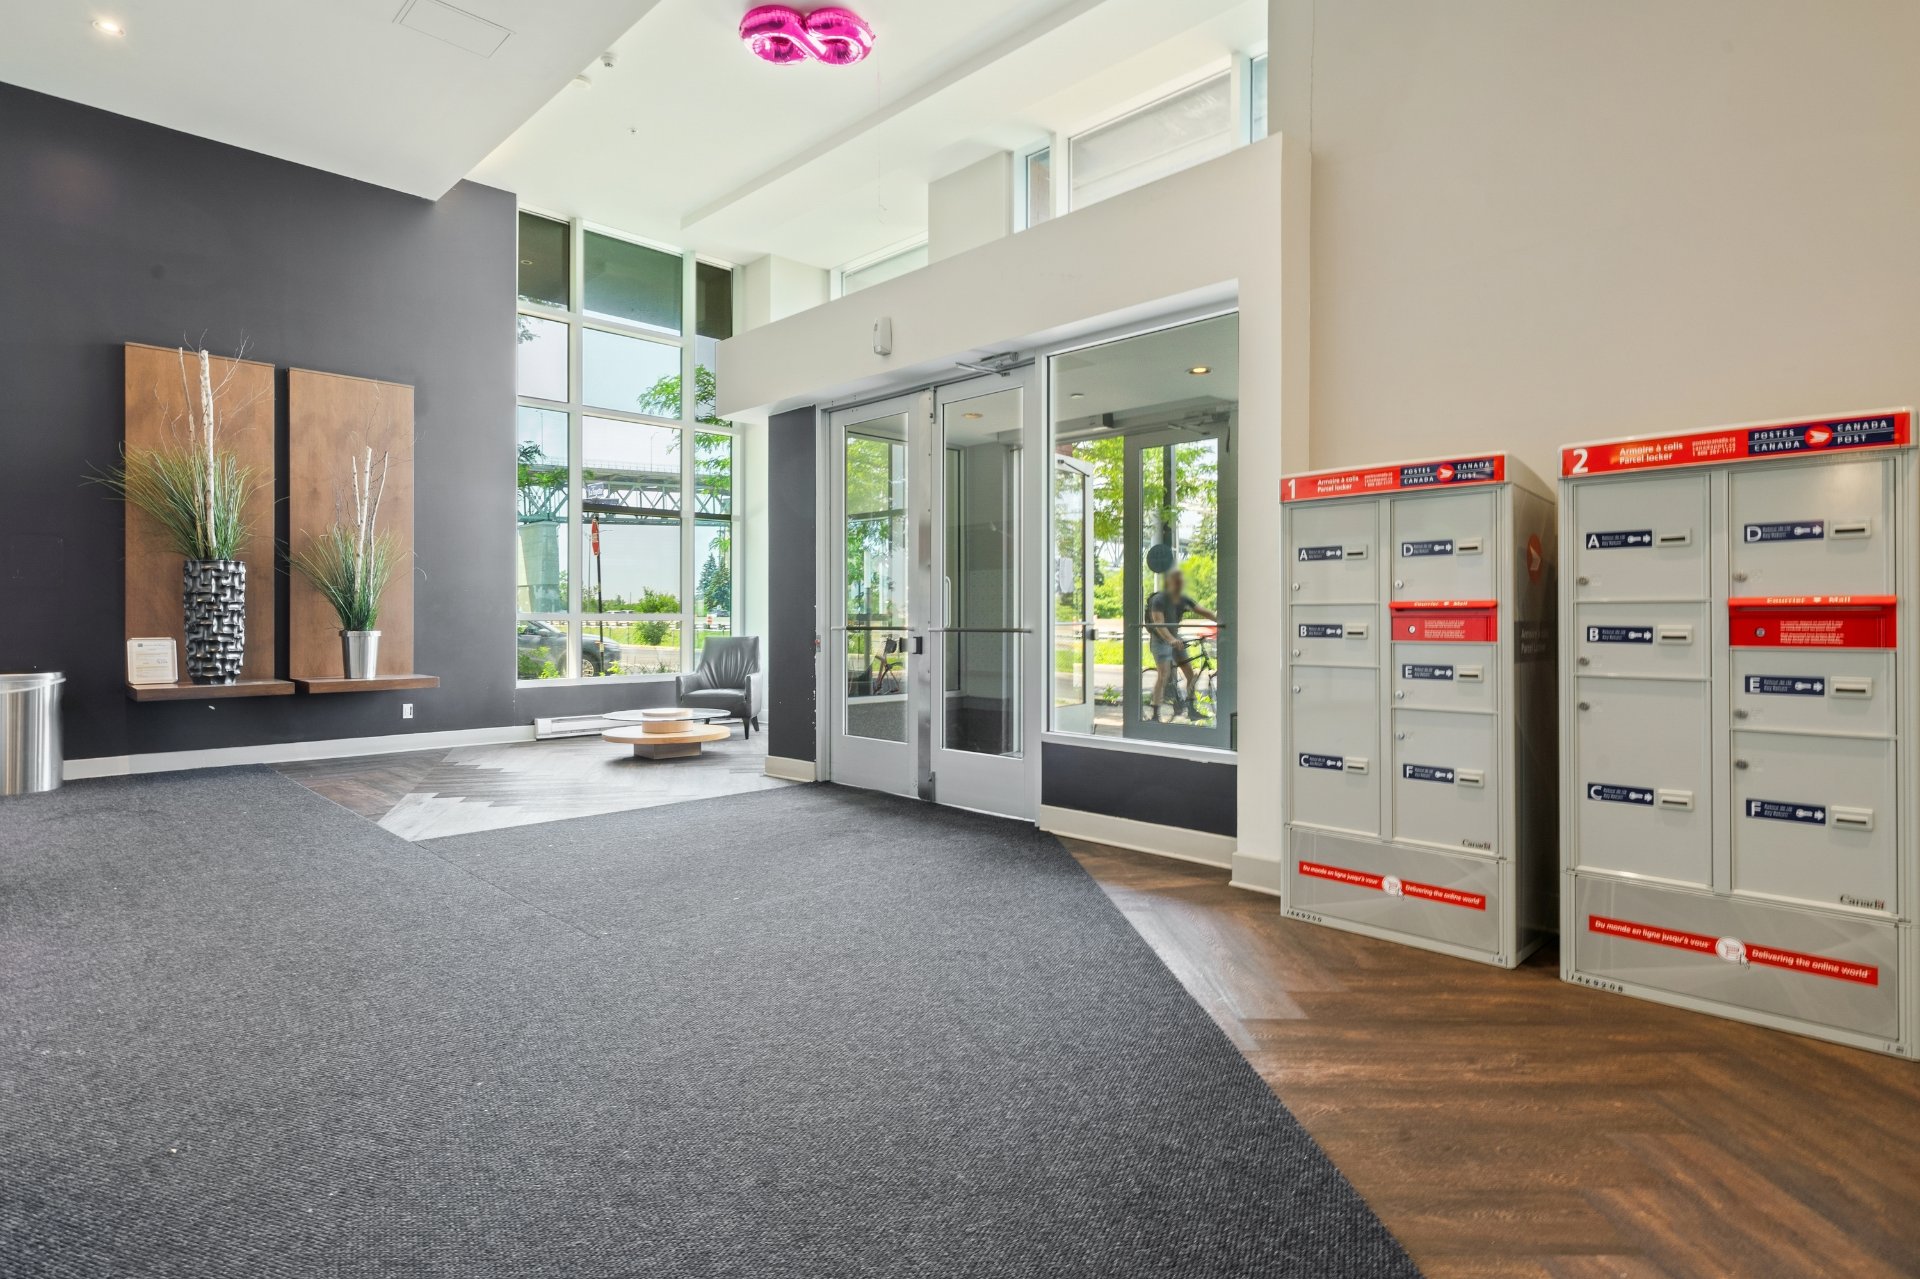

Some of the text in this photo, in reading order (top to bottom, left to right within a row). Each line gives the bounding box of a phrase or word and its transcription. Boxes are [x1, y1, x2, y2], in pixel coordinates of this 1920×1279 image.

[1836, 419, 1888, 432] CANADA
[1754, 428, 1795, 440] POSTES
[1837, 433, 1867, 444] POST
[1620, 442, 1683, 456] Armoire à colis
[1754, 440, 1800, 452] CANADA
[1457, 460, 1490, 470] CANADA
[1573, 448, 1588, 474] 2
[1620, 452, 1673, 465] Parcel locker
[1404, 466, 1431, 475] POSTES
[1457, 471, 1477, 480] POST
[1317, 477, 1340, 486] Armoire
[1346, 475, 1359, 483] colis
[1404, 475, 1434, 484] CANADA
[1288, 478, 1296, 499] 1
[1318, 483, 1352, 493] Parcel locker
[1747, 525, 1762, 542] D
[1588, 534, 1600, 549] A
[1299, 549, 1308, 561] A
[1403, 543, 1414, 557] D
[1300, 625, 1307, 636] B
[1590, 627, 1599, 642] B
[1405, 666, 1413, 678] E
[1749, 677, 1760, 693] E
[1300, 755, 1309, 767] C
[1405, 765, 1414, 778] F
[1590, 785, 1602, 800] C
[1751, 801, 1762, 817] F
[1303, 864, 1310, 872] Du
[1311, 867, 1327, 875] monde
[1405, 884, 1480, 905] Delivering the online world
[1595, 920, 1605, 928] Du
[1606, 924, 1631, 934] monde
[1642, 929, 1661, 939] ligne
[1690, 939, 1709, 949] vous
[1752, 949, 1868, 979] Delivering the online world
